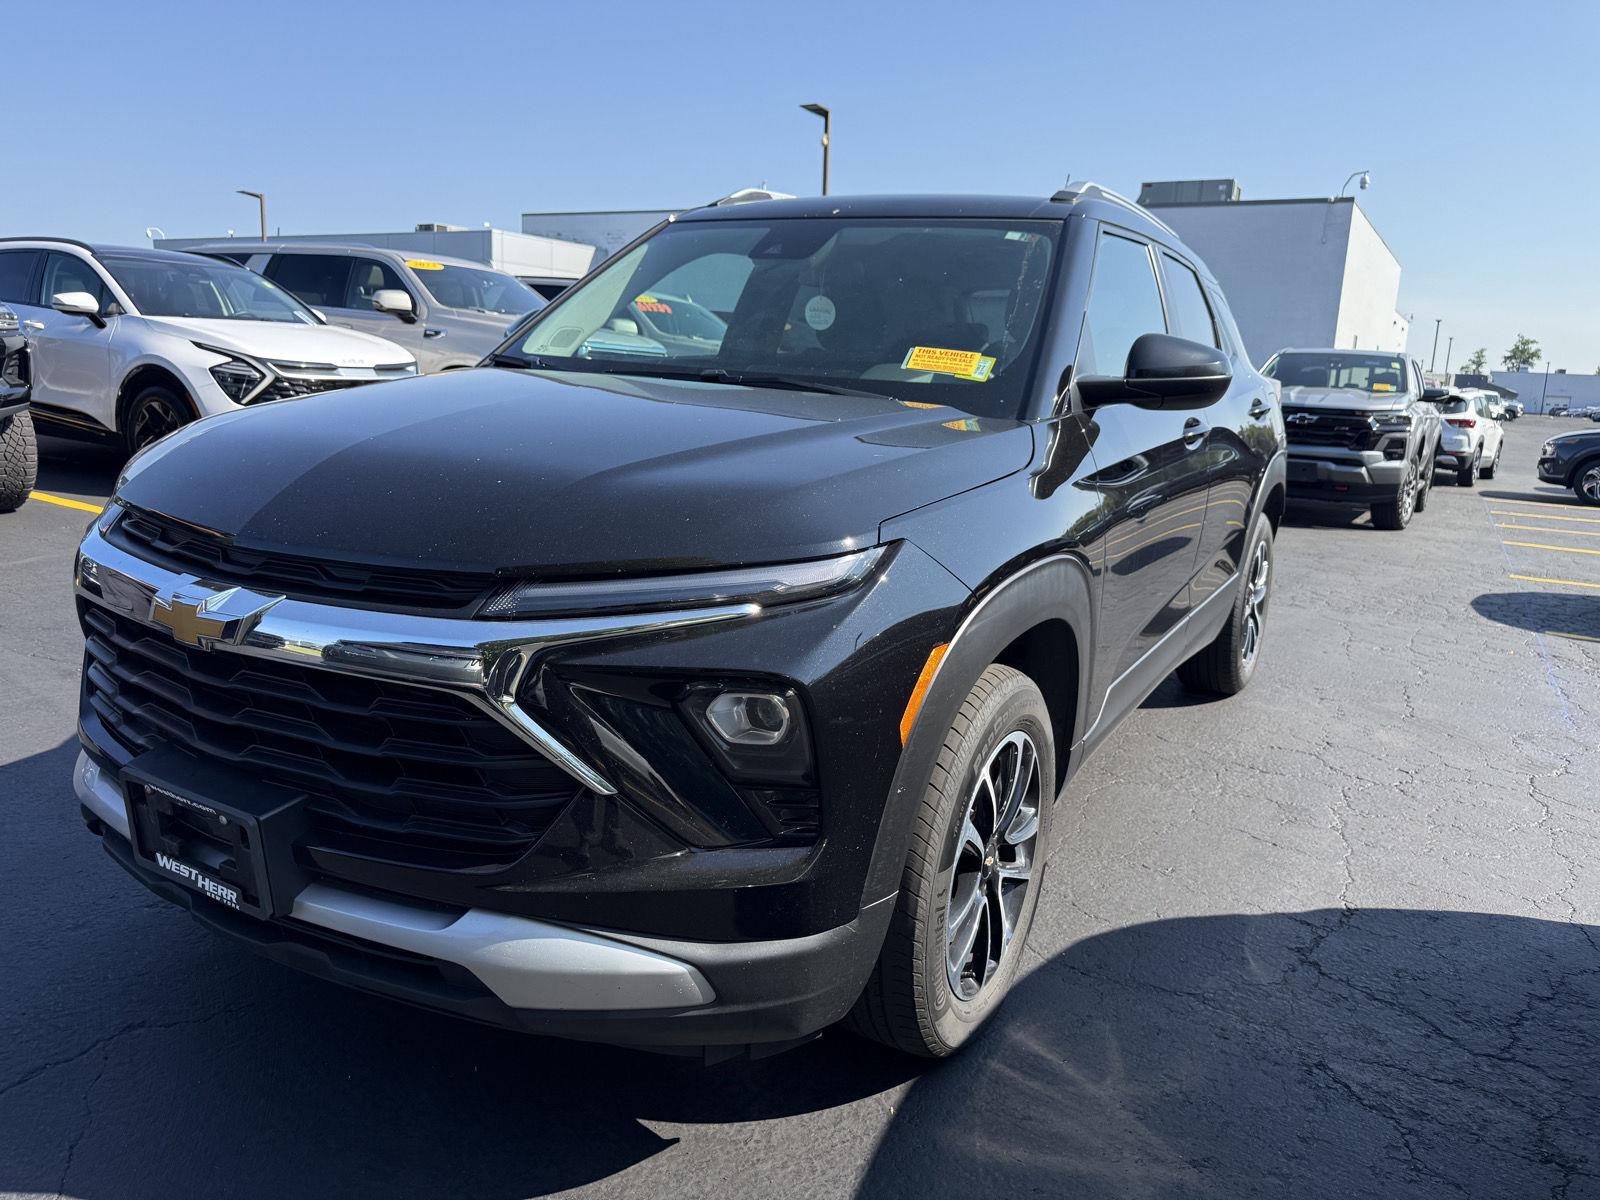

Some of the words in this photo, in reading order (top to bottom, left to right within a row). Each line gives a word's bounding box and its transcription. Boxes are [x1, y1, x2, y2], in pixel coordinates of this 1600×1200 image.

[939, 350, 976, 359] VEHICLE
[206, 891, 221, 901] NEW
[223, 899, 240, 911] YORK
